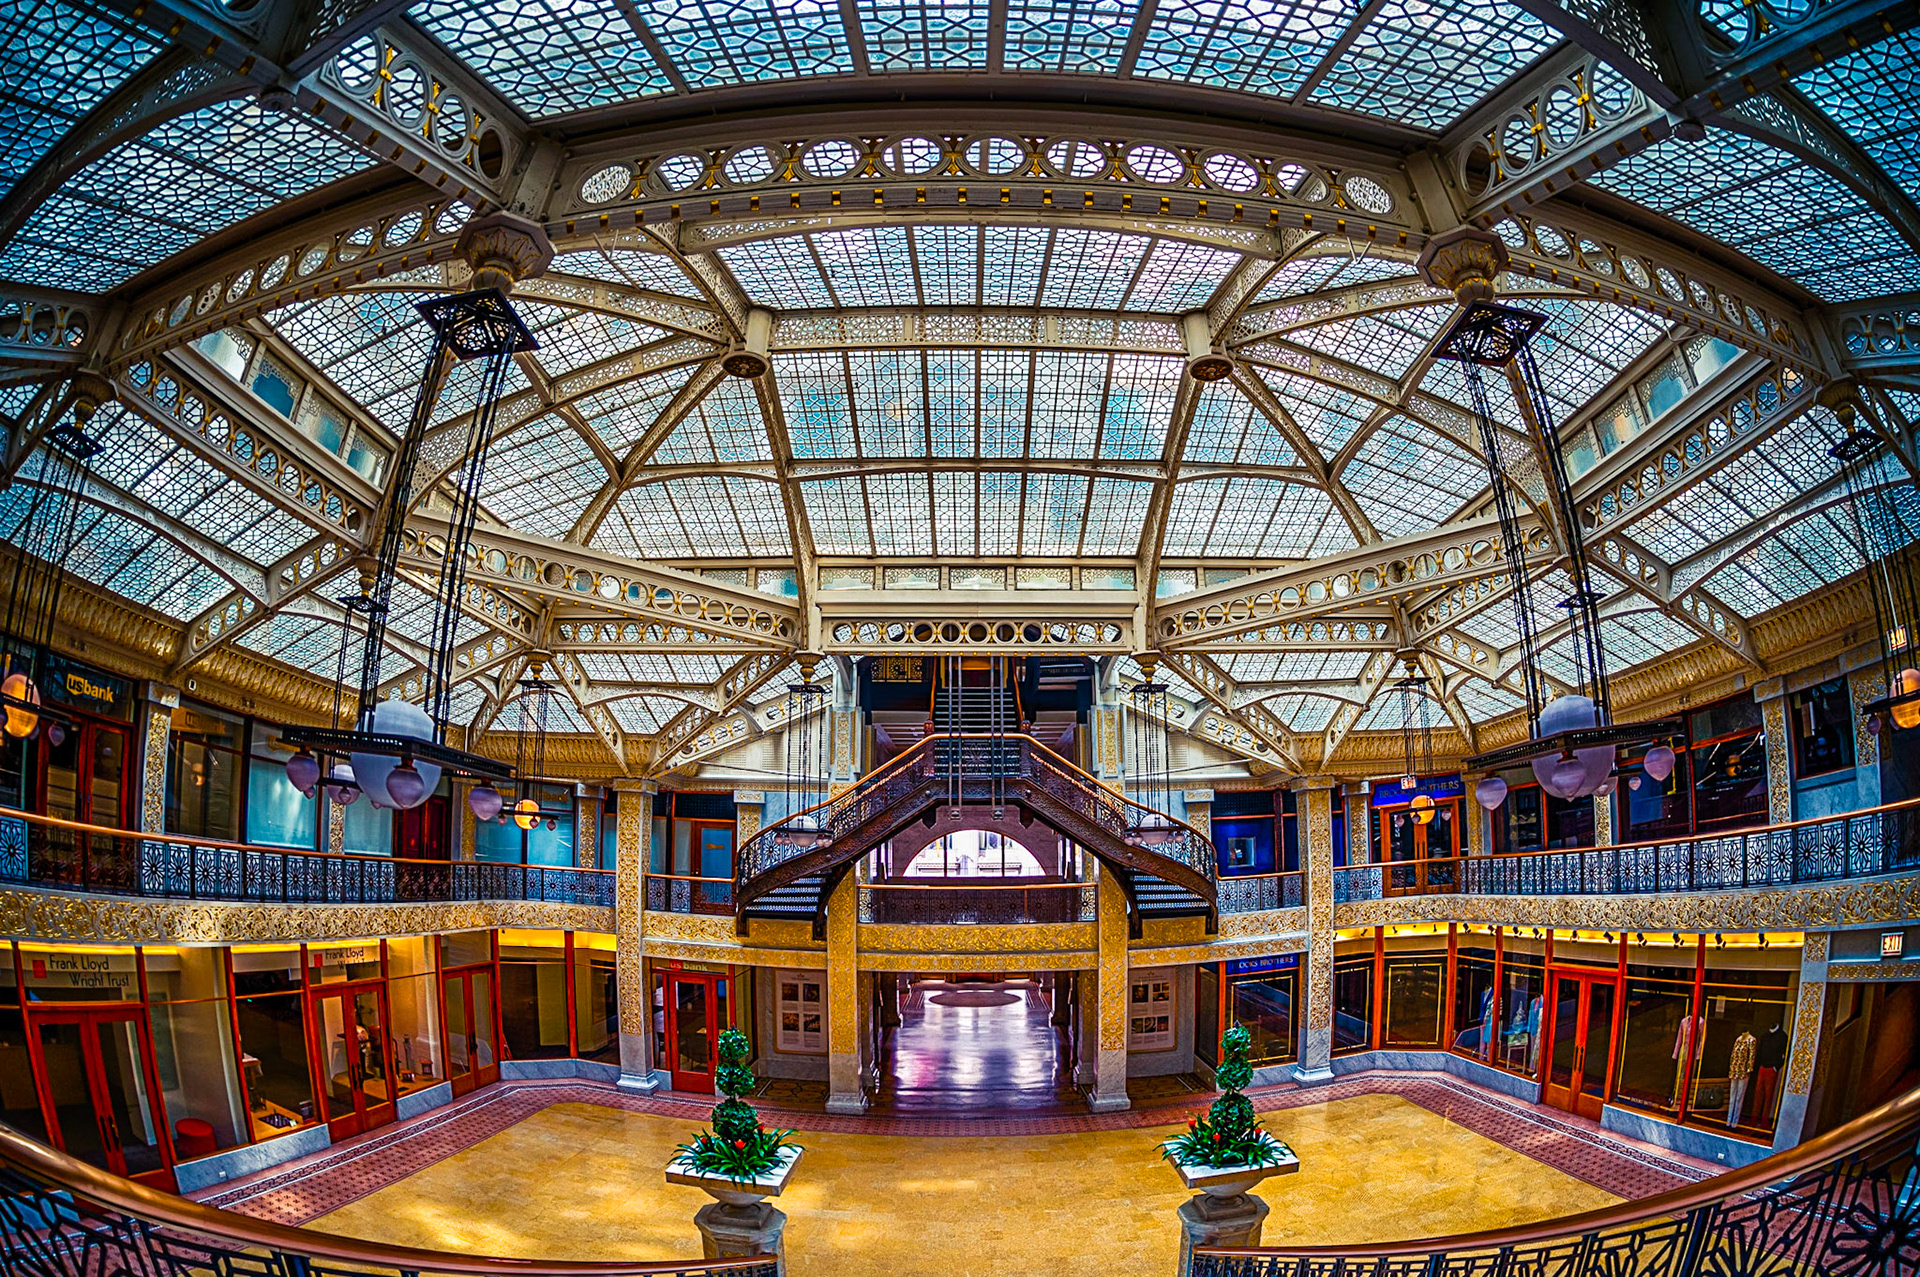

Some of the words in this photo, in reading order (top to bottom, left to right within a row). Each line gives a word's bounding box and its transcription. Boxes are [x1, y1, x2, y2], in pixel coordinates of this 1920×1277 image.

[1883, 935, 1903, 951] EXIT
[326, 949, 344, 960] Frank
[346, 947, 364, 959] Lloyd
[49, 954, 78, 969] Frank
[81, 955, 109, 972] Lloyd
[69, 972, 104, 987] Wright
[107, 973, 129, 986] Trust
